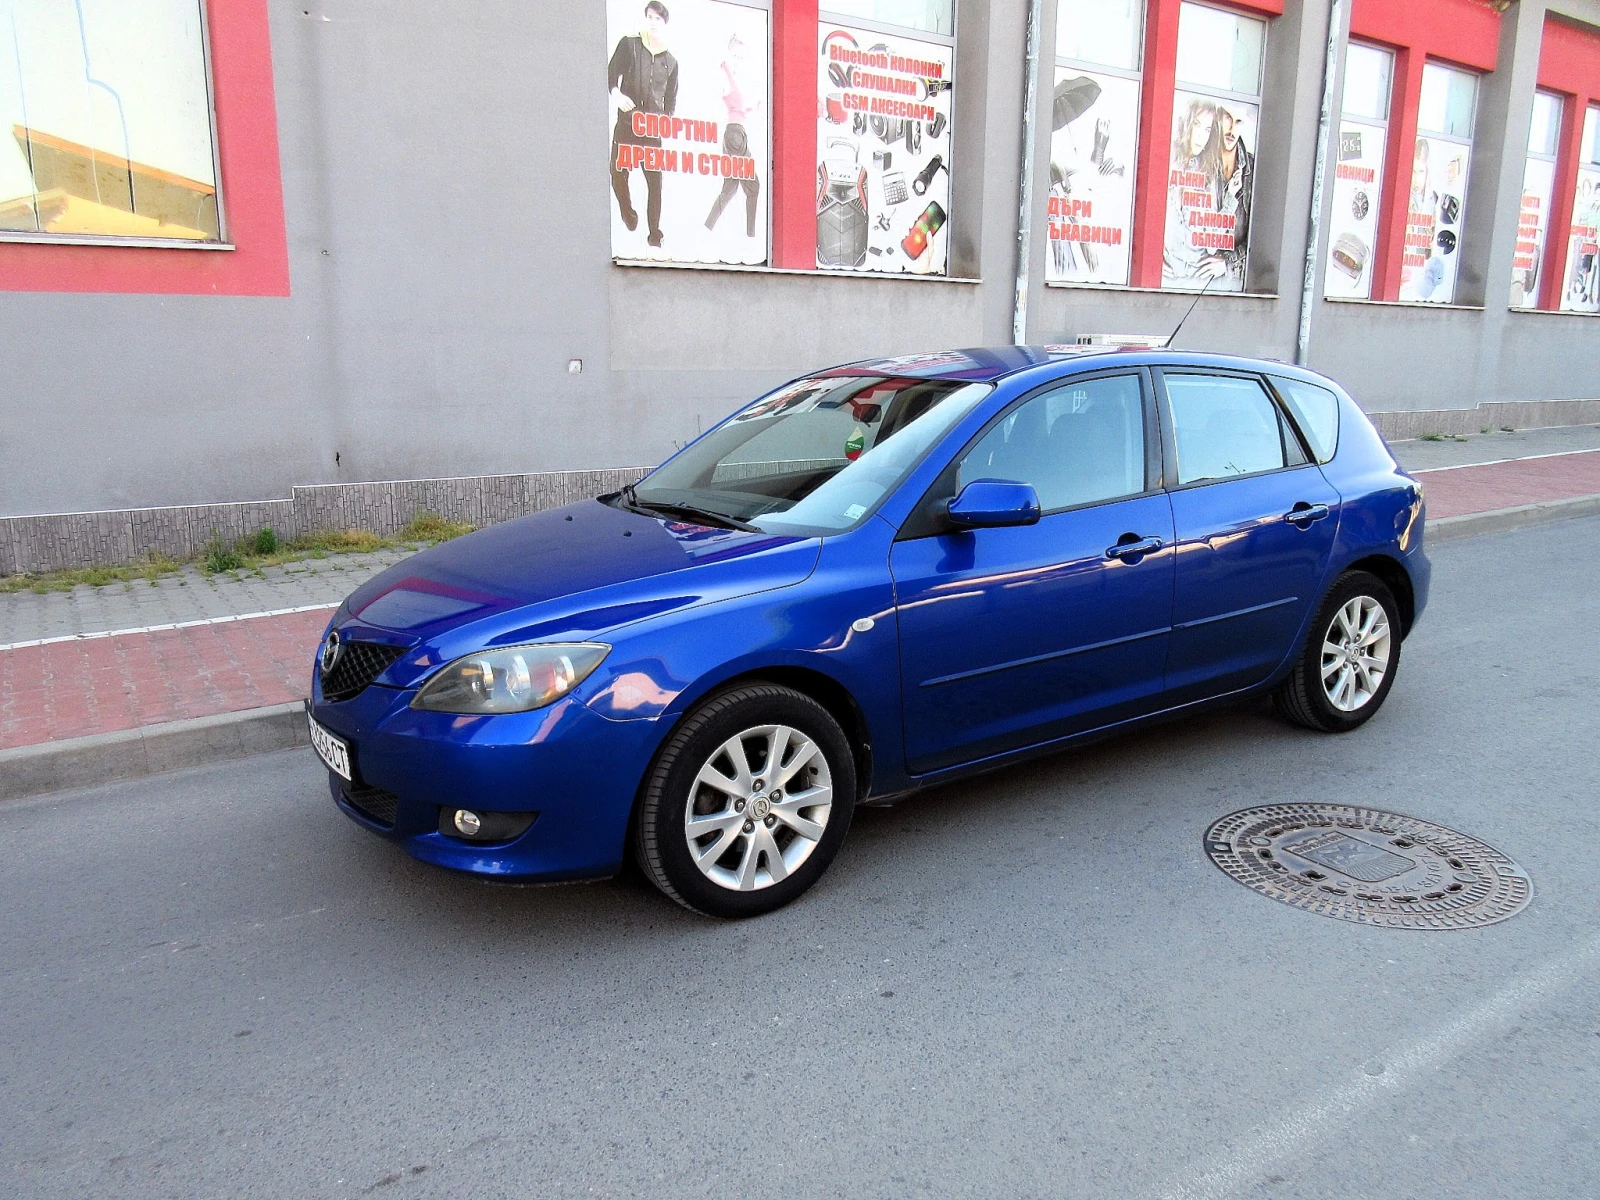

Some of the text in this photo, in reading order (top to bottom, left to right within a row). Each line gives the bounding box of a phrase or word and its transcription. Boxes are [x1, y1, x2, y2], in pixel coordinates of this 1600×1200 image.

[829, 44, 943, 79] Bluetooth КОЛОНКИ
[852, 71, 917, 97] СЛУШАЛКИ
[843, 92, 935, 121] GSM АКСЕСОАРИ
[632, 112, 718, 143] СПОРТНИ
[616, 145, 755, 180] ДРЕХИ И СТОКИ
[1169, 169, 1205, 188] ДЪНКИ
[1183, 191, 1212, 209] ЯКЕТА
[1188, 210, 1235, 229] ДЪНКОВИ
[1191, 231, 1234, 249] ОБЛЕКЛА
